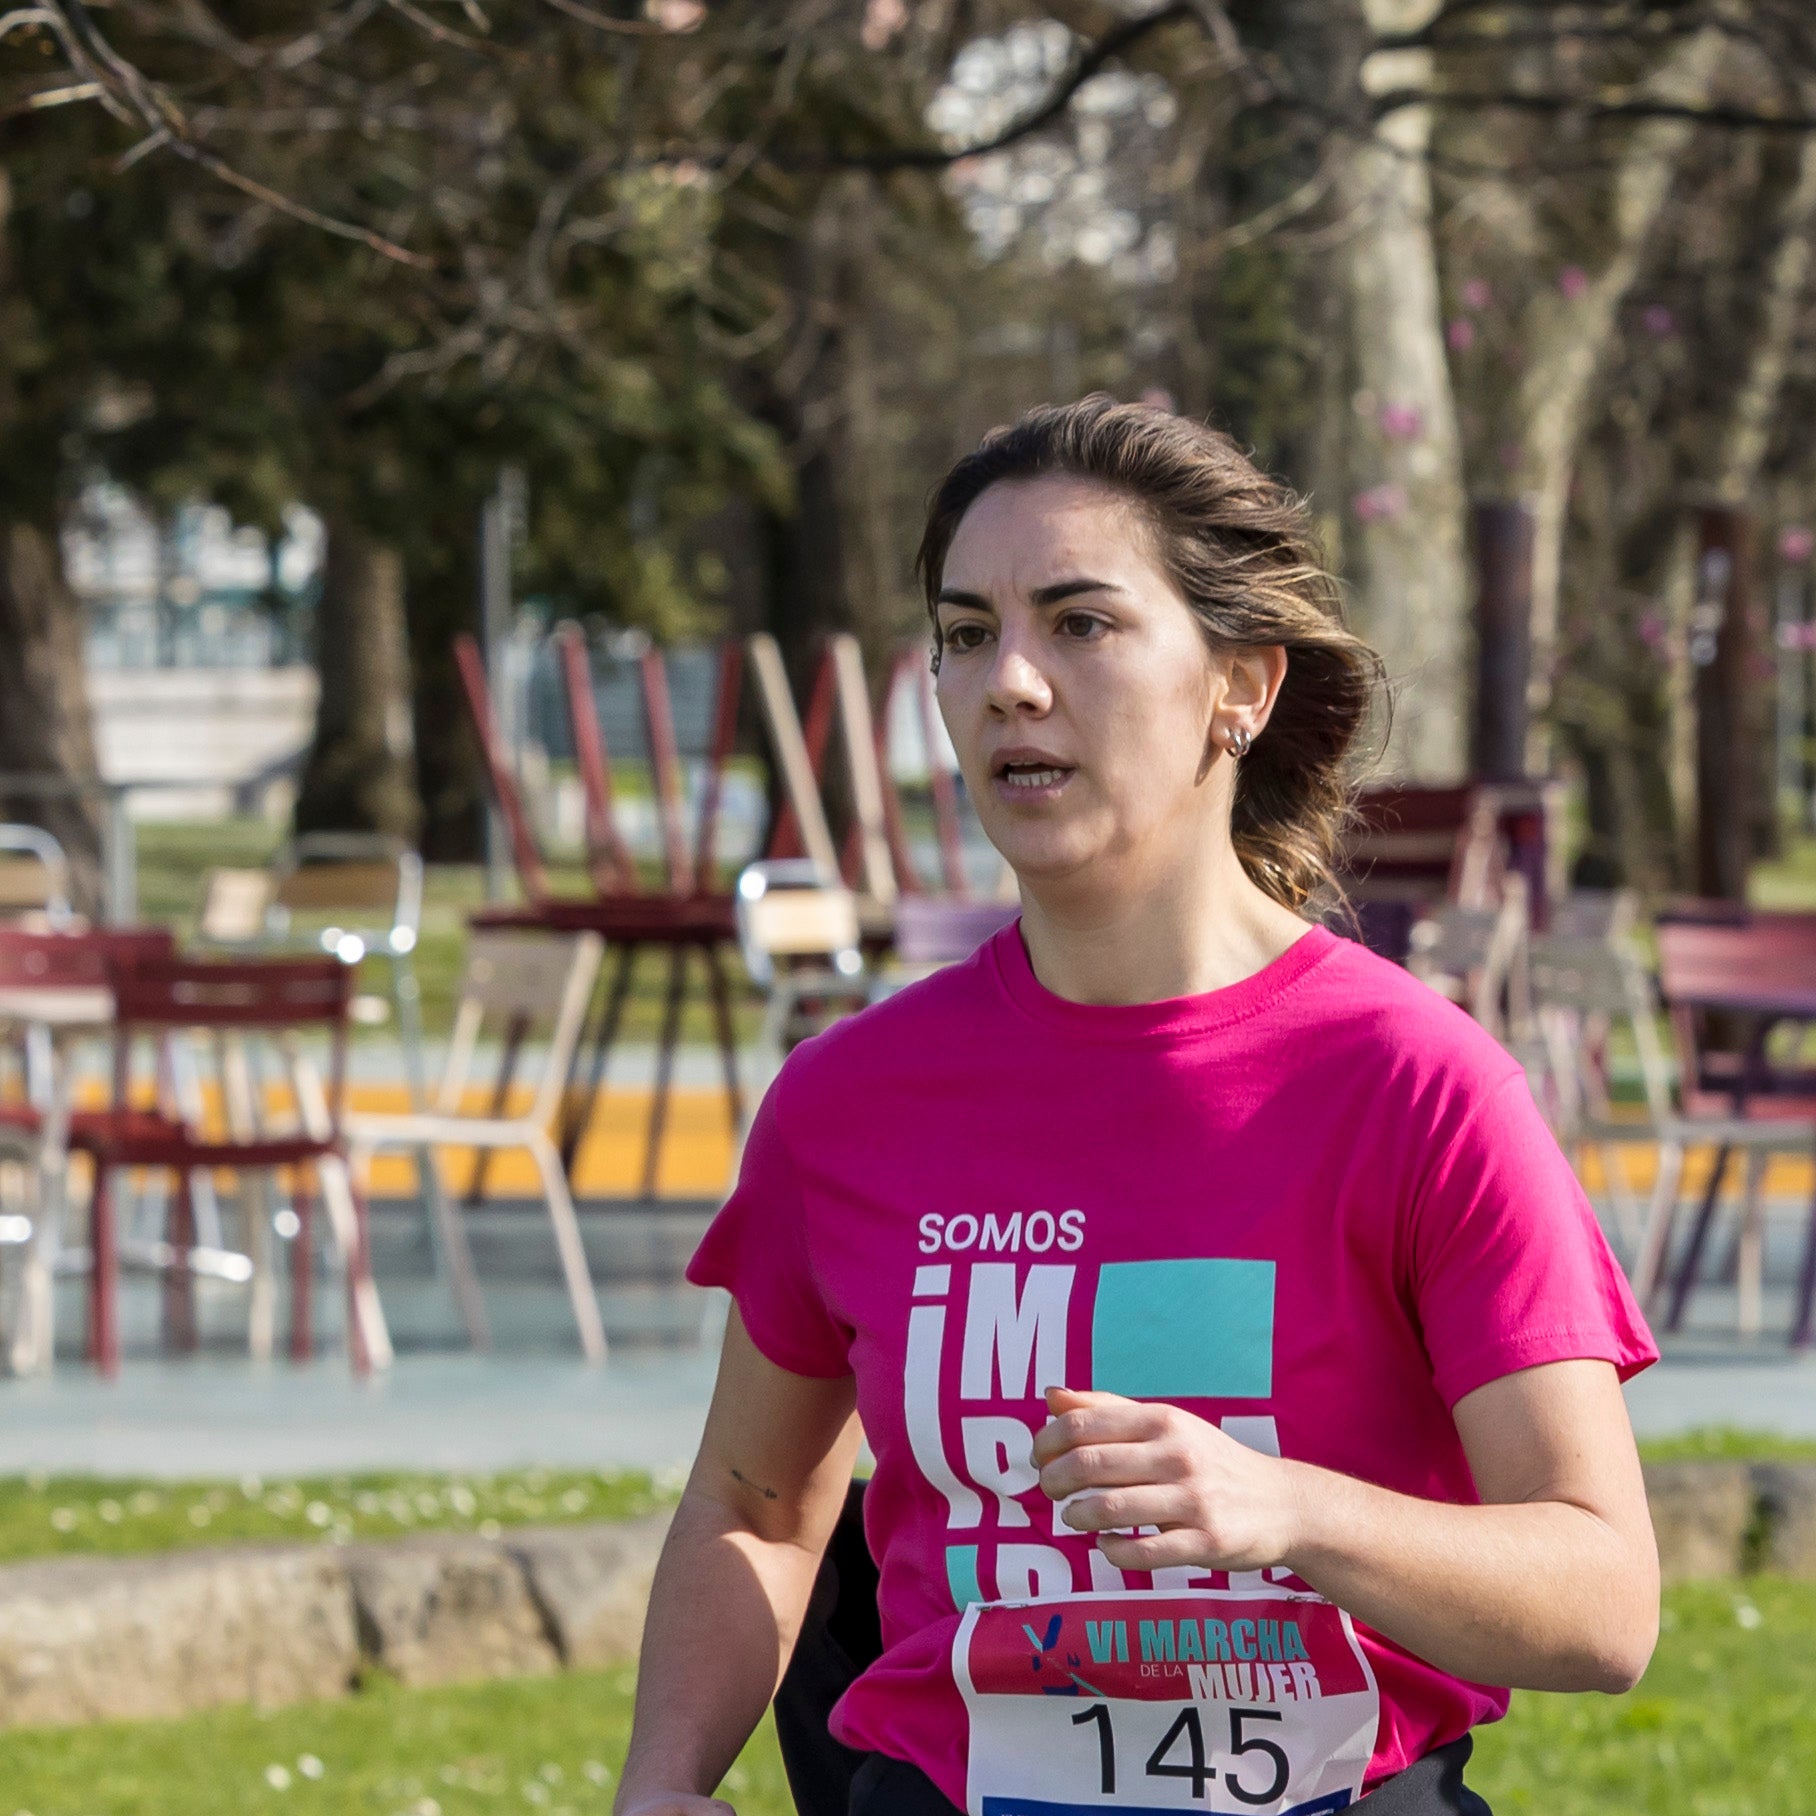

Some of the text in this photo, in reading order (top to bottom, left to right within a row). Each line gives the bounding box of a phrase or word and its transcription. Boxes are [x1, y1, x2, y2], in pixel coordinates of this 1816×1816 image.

[918, 1209, 1086, 1255] SOMOS
[1085, 1618, 1312, 1664] VI MARCHA
[1140, 1662, 1323, 1702] DE LA MUJER
[1071, 1703, 1290, 1806] 145
